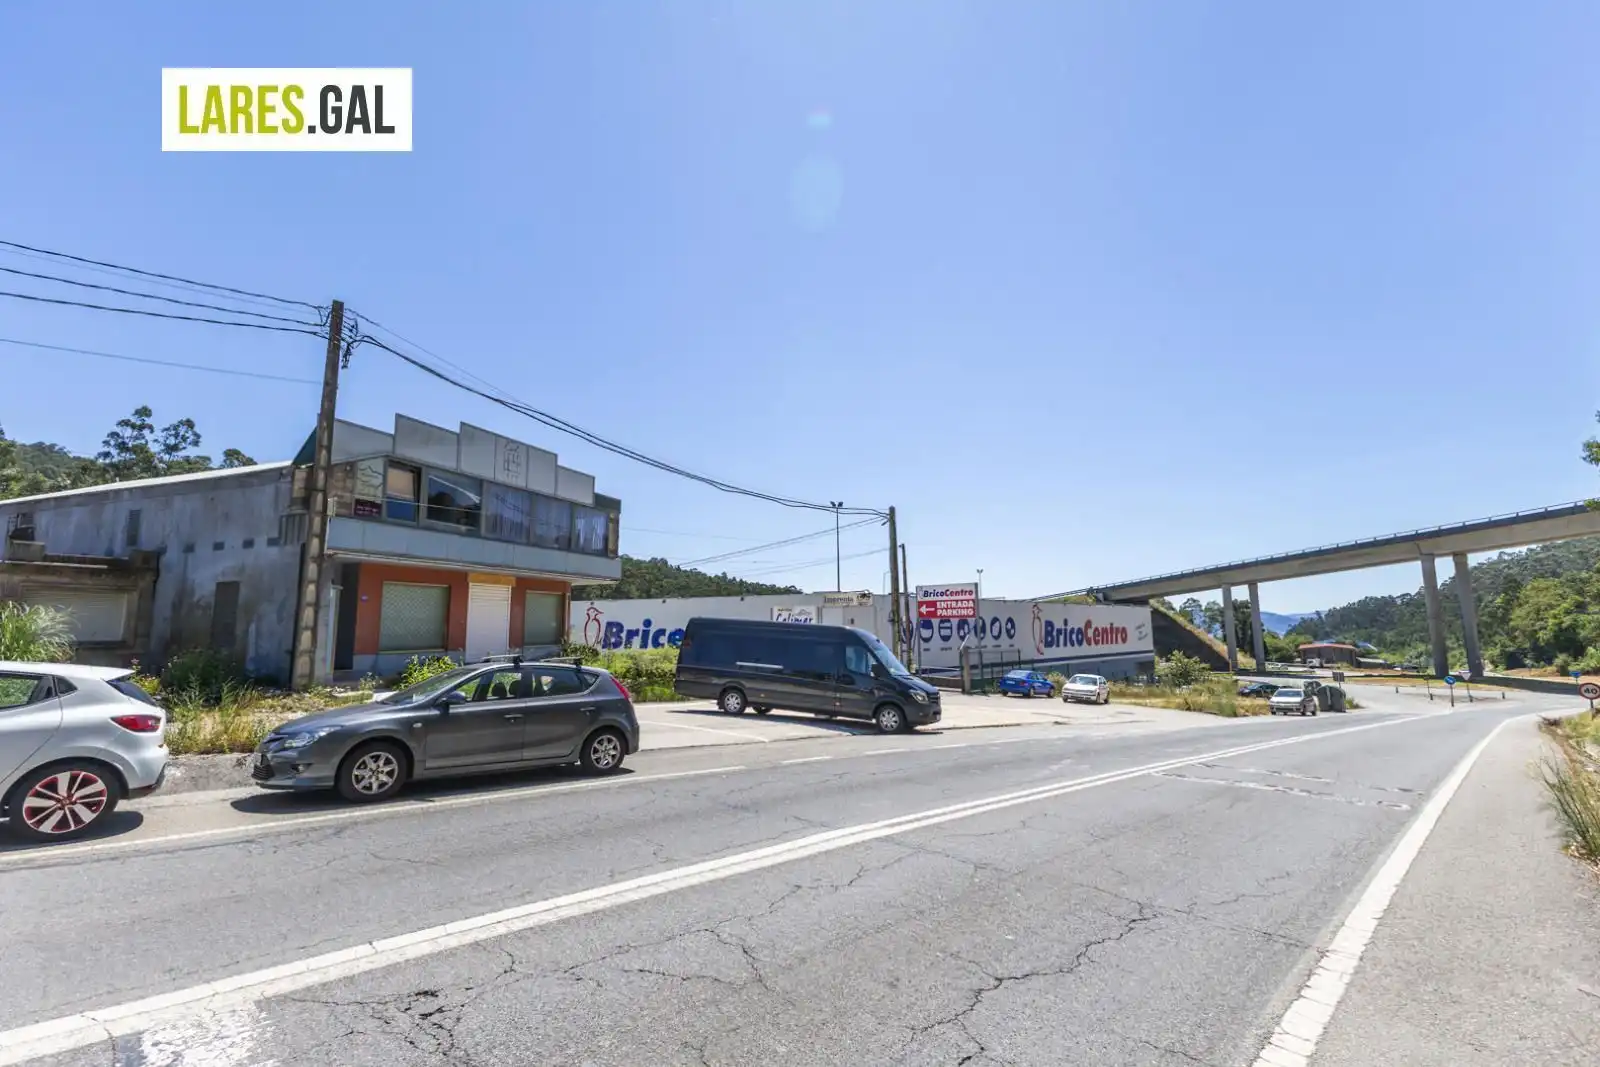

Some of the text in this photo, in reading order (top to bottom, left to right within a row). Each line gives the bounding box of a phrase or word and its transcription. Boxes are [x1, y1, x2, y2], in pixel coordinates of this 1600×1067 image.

[923, 589, 974, 598] BricoCentro
[936, 601, 974, 609] ENTRADA
[936, 608, 974, 616] PARKING
[1044, 618, 1128, 648] BricoCentro
